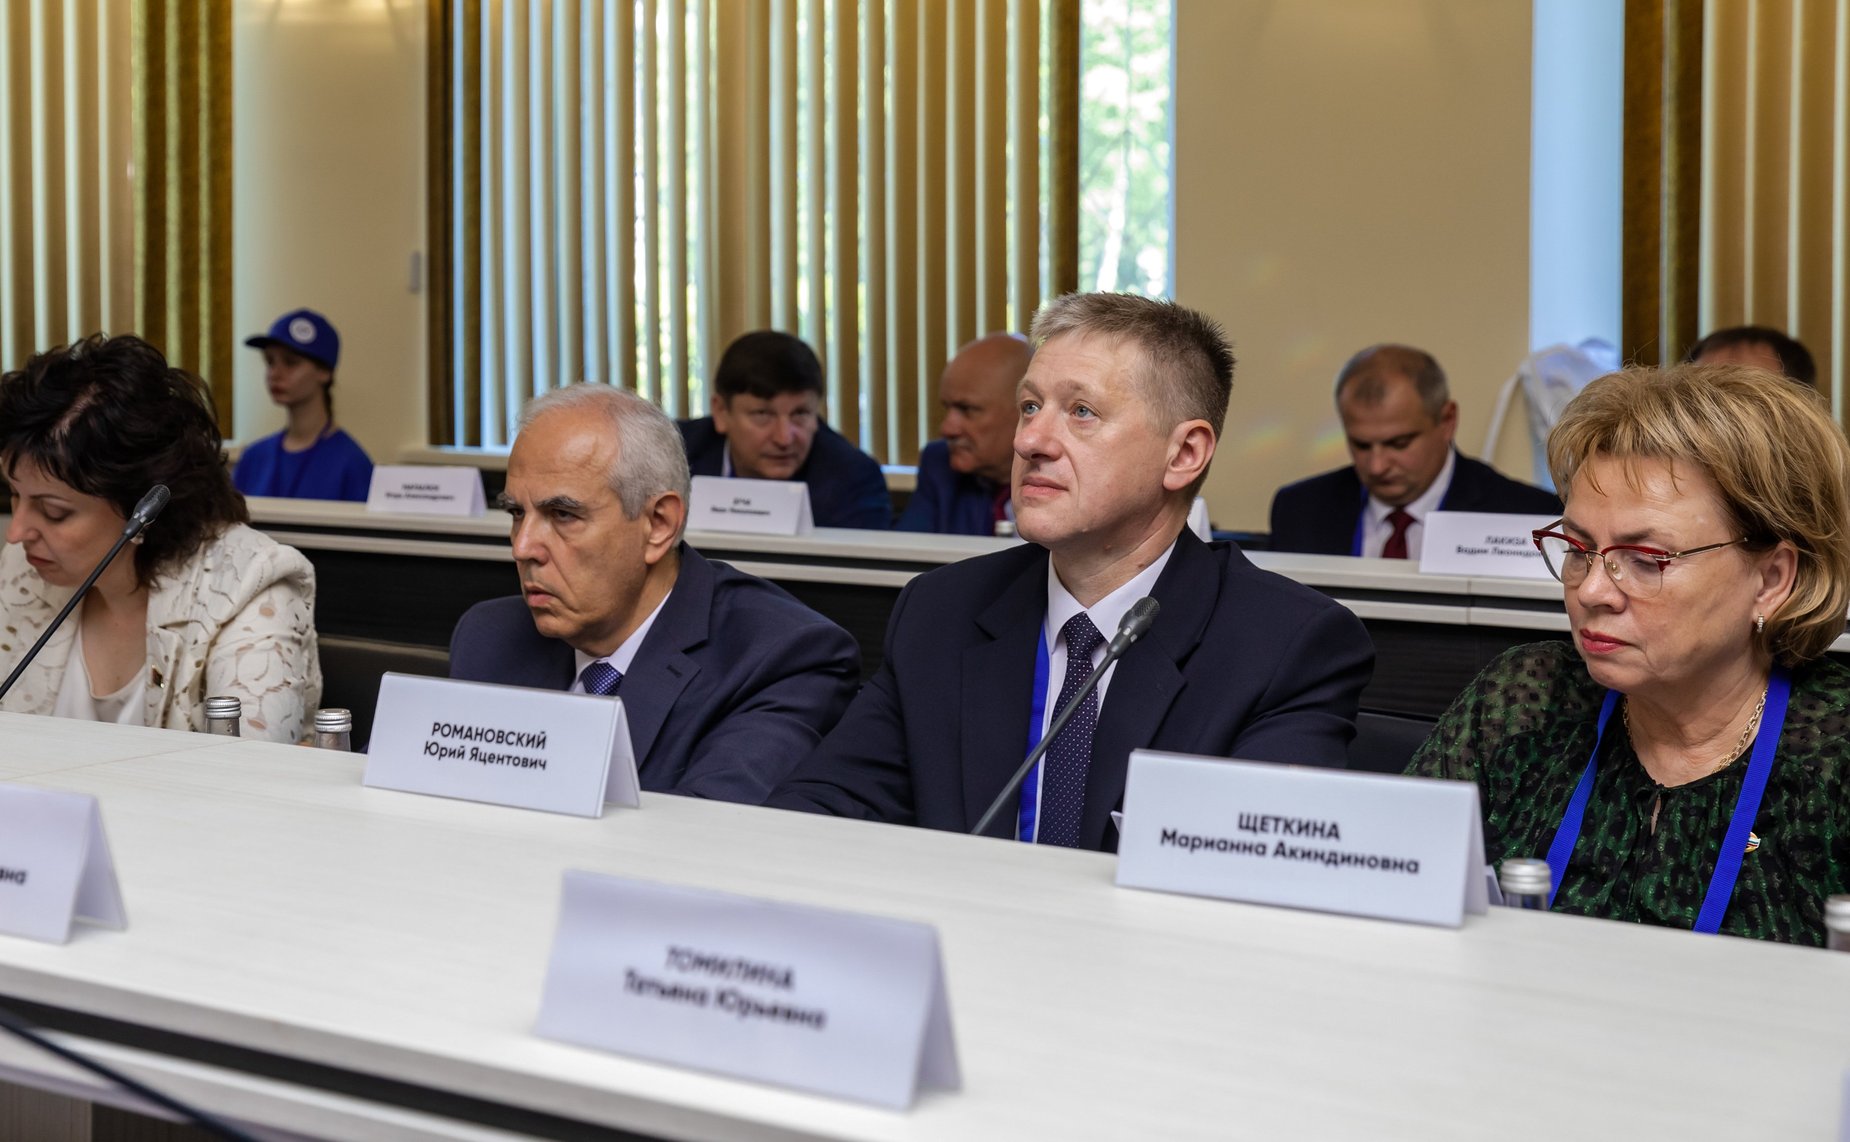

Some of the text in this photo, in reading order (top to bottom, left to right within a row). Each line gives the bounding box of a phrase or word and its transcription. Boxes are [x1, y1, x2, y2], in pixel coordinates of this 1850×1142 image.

[431, 721, 547, 750] РОМАНОВСКИЙ
[423, 740, 548, 771] Юрий Яцентович
[1237, 812, 1342, 842] ЩЕТКИНА
[1159, 827, 1421, 875] Марианна Акиндиновна
[665, 945, 796, 991] ТОМИЛИНА
[624, 967, 828, 1031] Татьяна Юрьевна
